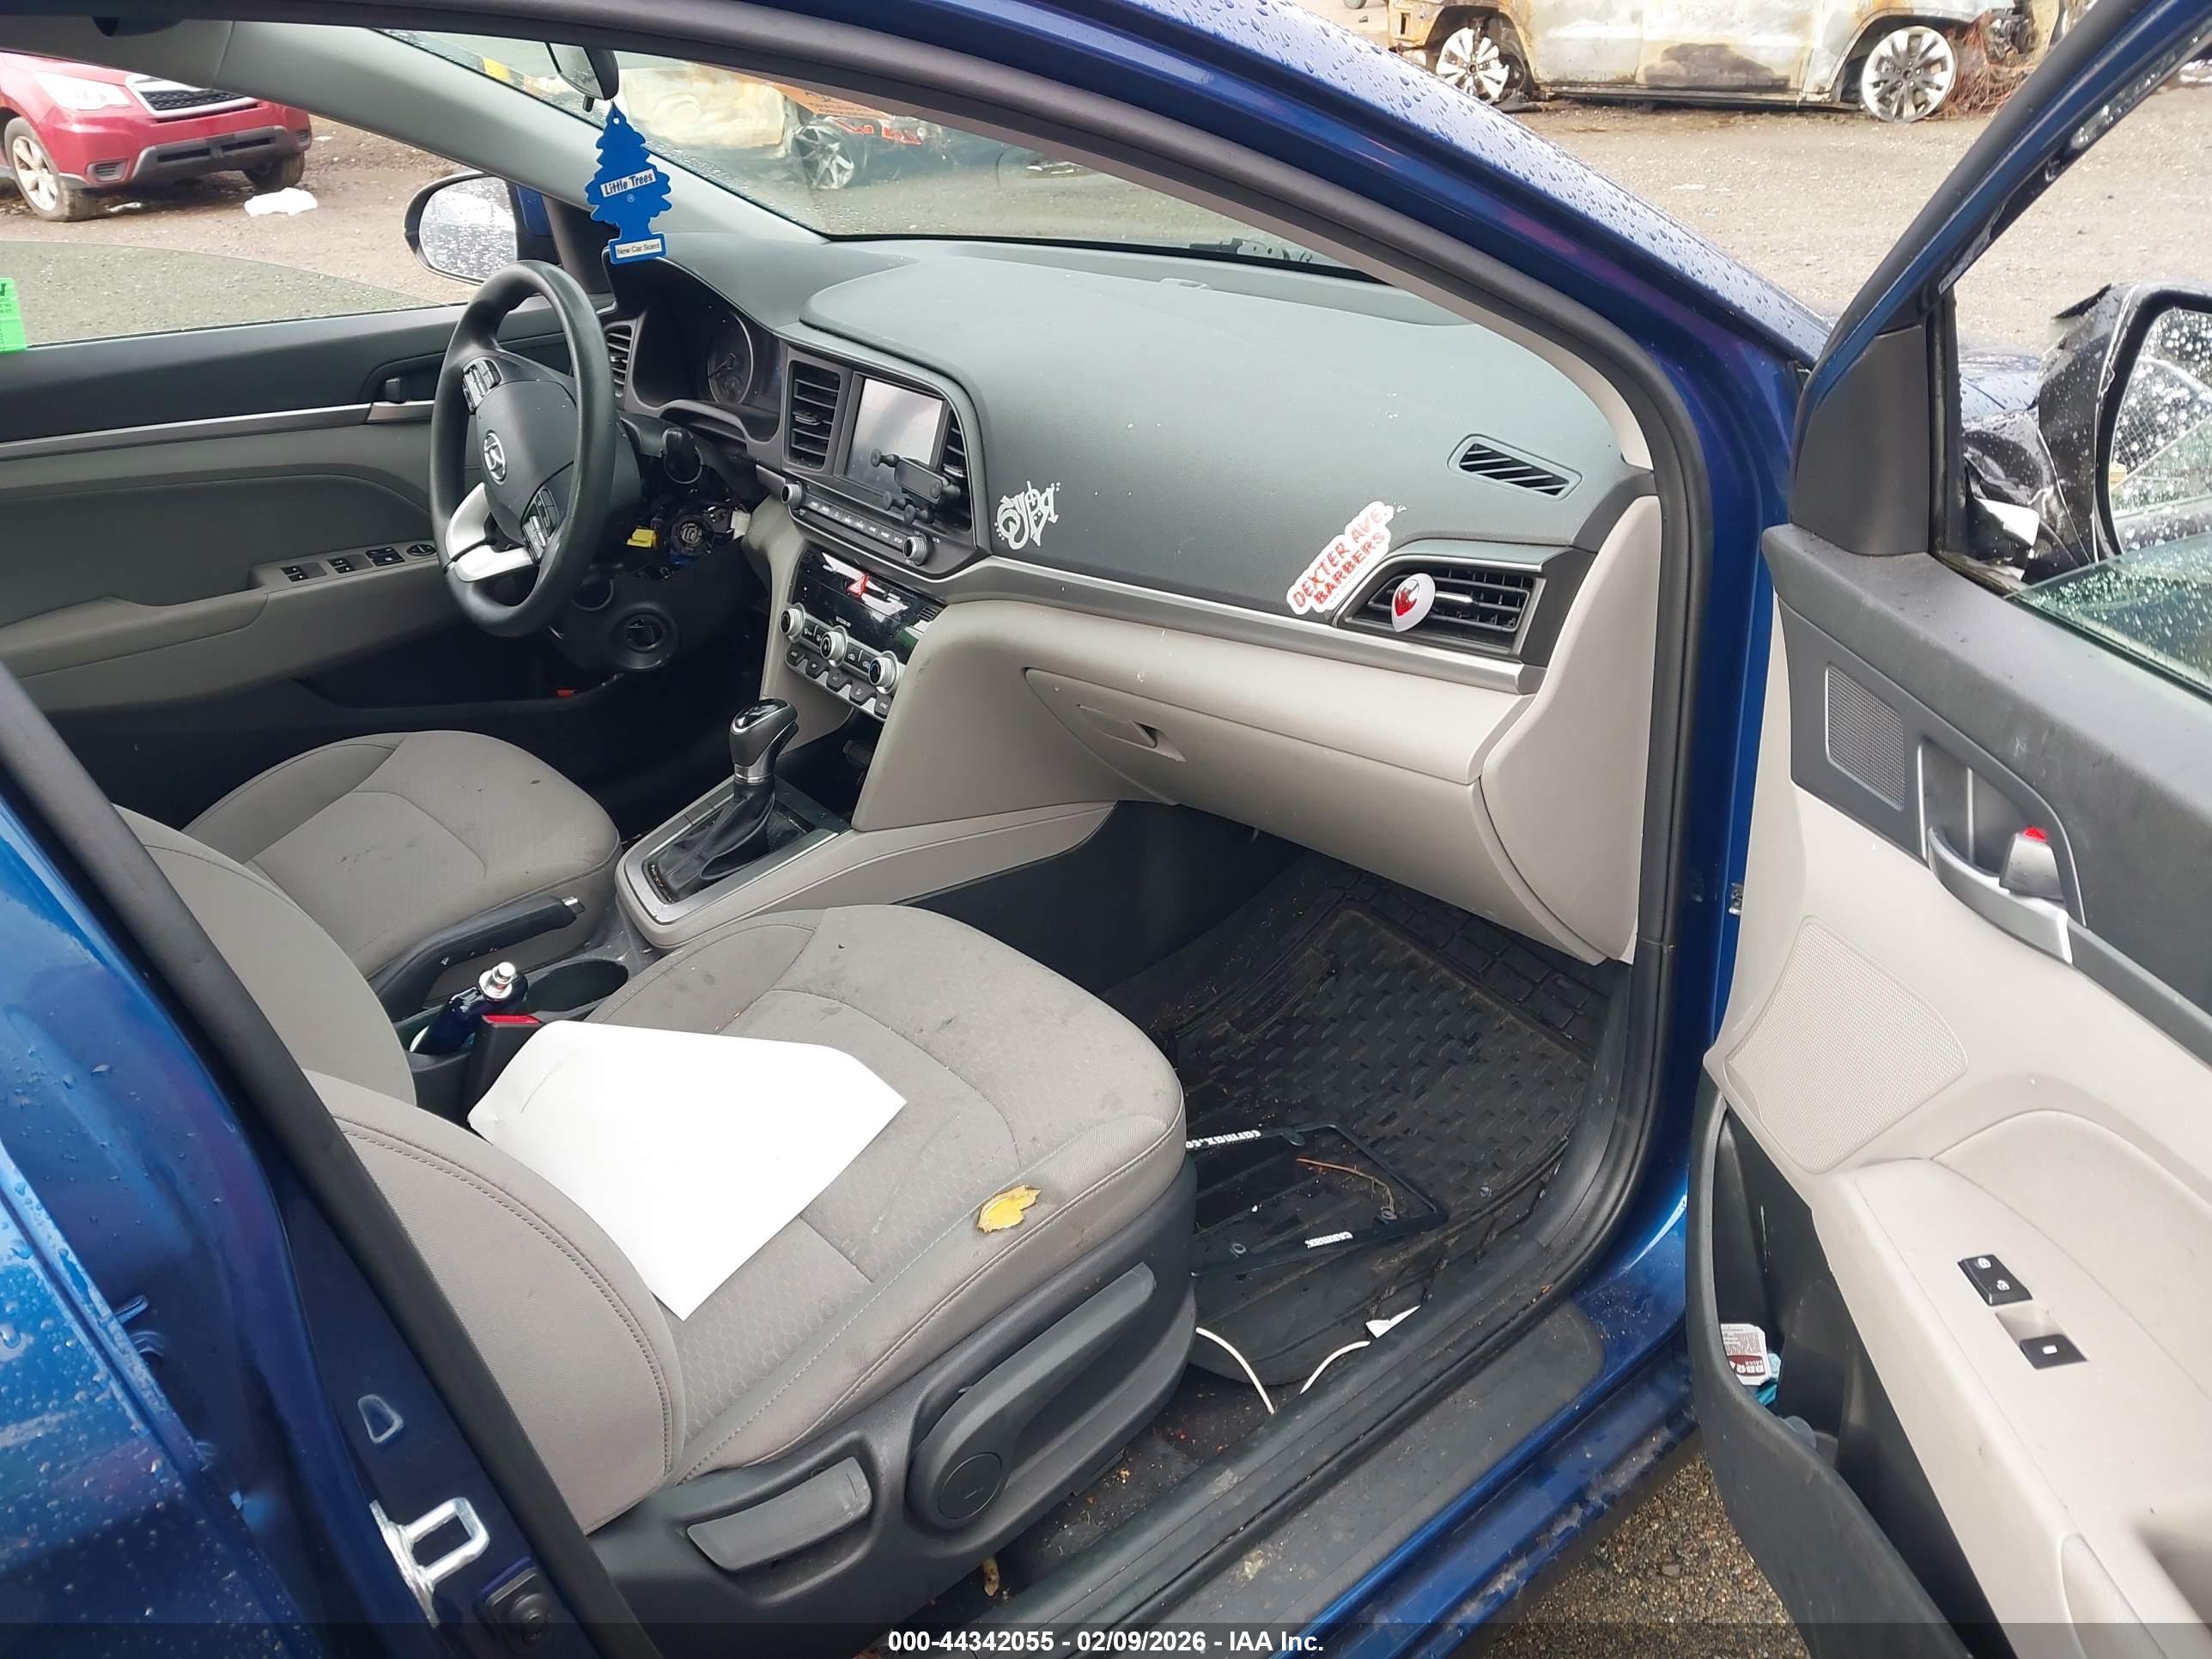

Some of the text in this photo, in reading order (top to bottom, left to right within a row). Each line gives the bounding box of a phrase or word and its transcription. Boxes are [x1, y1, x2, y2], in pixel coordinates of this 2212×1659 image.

[605, 173, 653, 195] Little Trees
[1292, 543, 1350, 608] DEXTER
[1313, 532, 1385, 605] BARBERS
